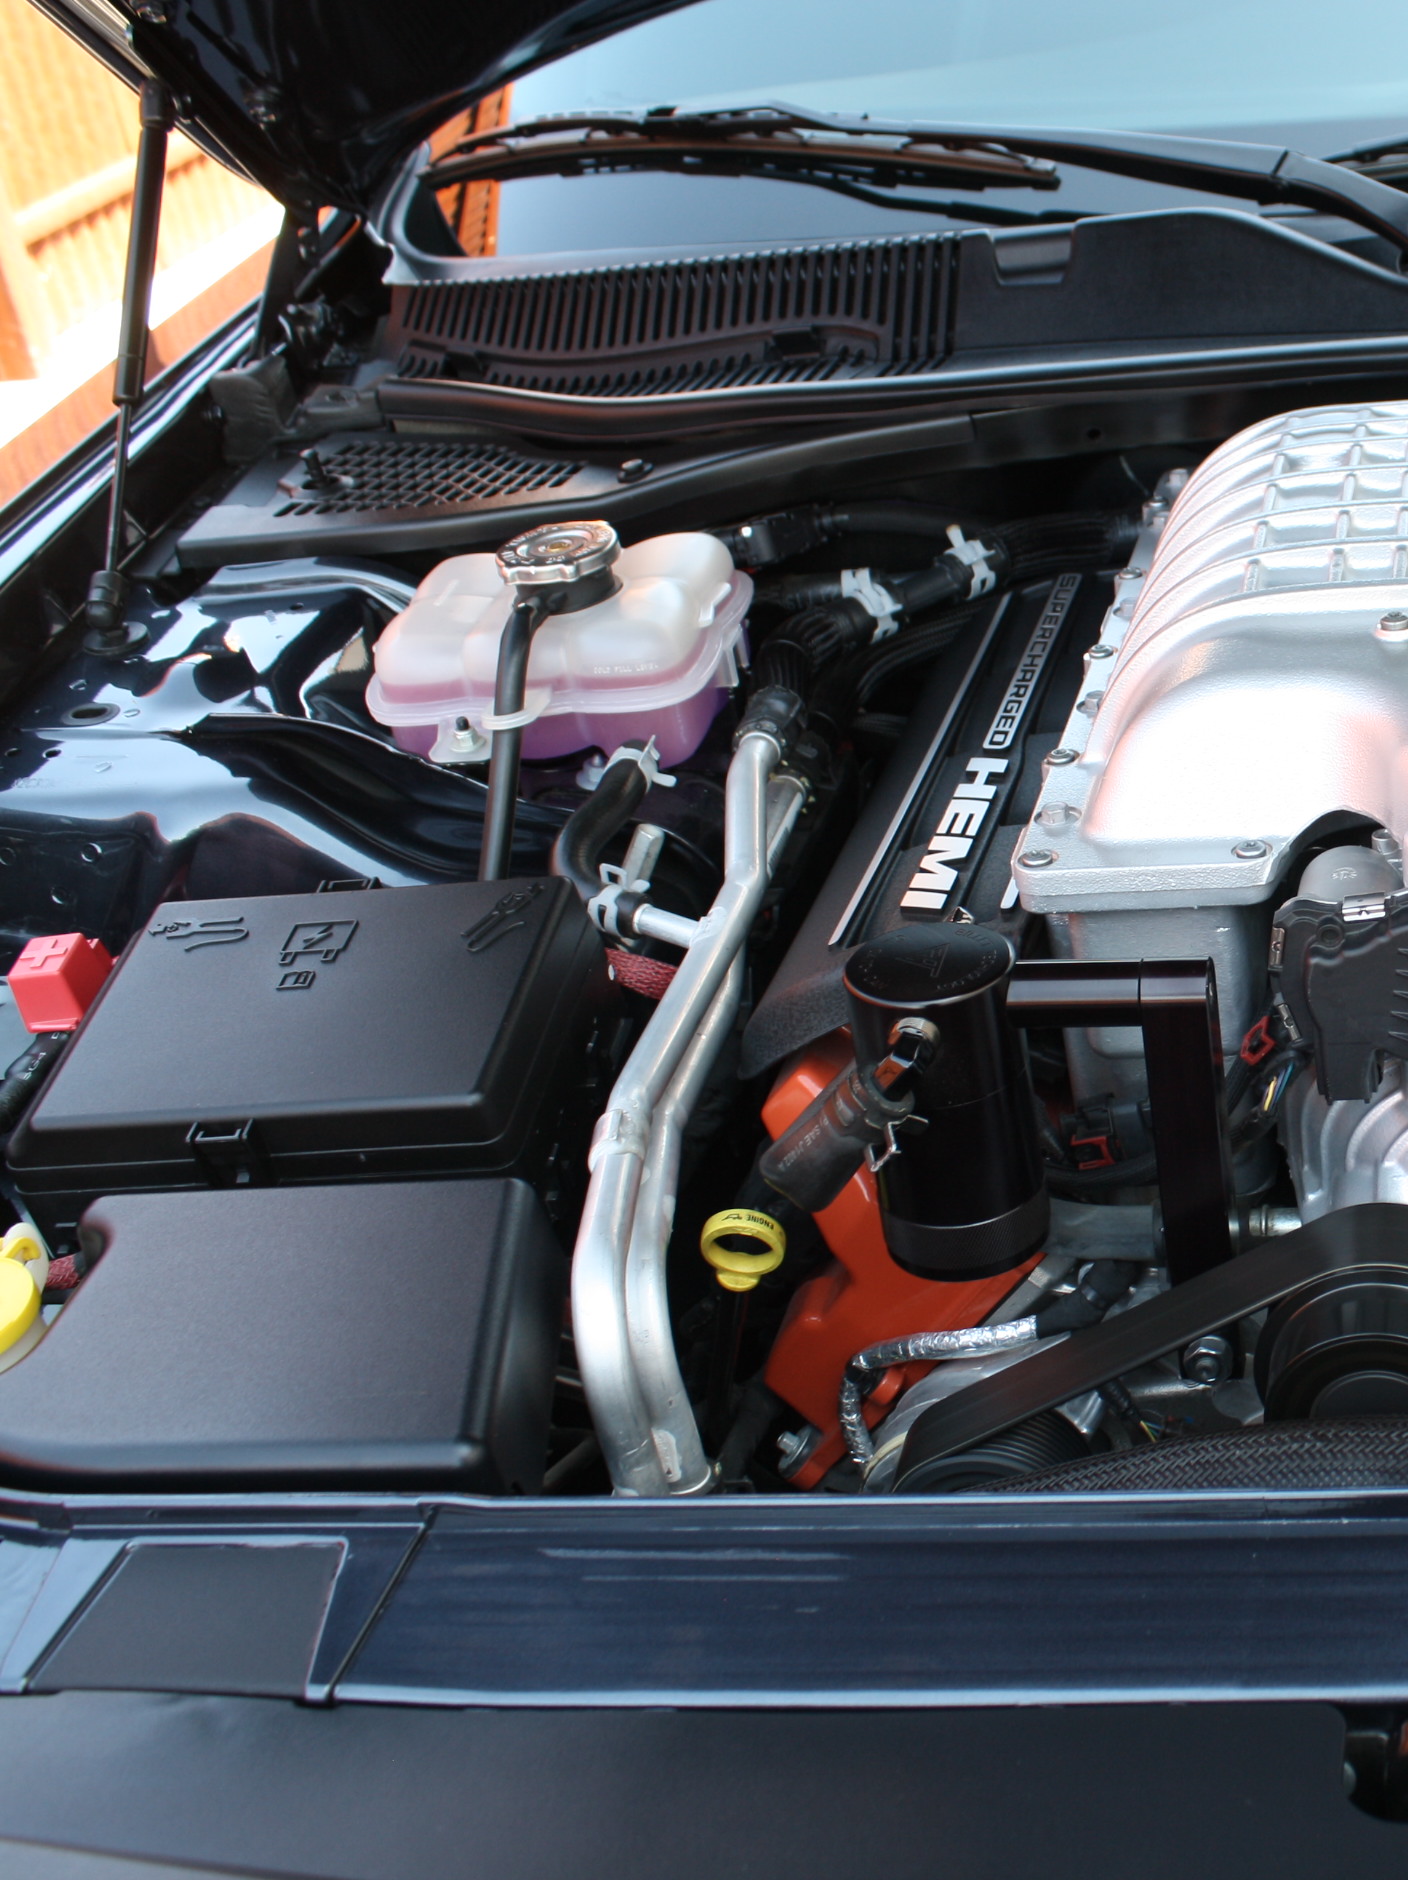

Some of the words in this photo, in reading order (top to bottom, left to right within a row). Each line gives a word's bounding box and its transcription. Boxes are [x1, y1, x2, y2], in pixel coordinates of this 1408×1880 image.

[987, 574, 1079, 748] SUPERCHARGED
[900, 757, 1006, 910] HEMI
[745, 1214, 775, 1230] ENGINE
